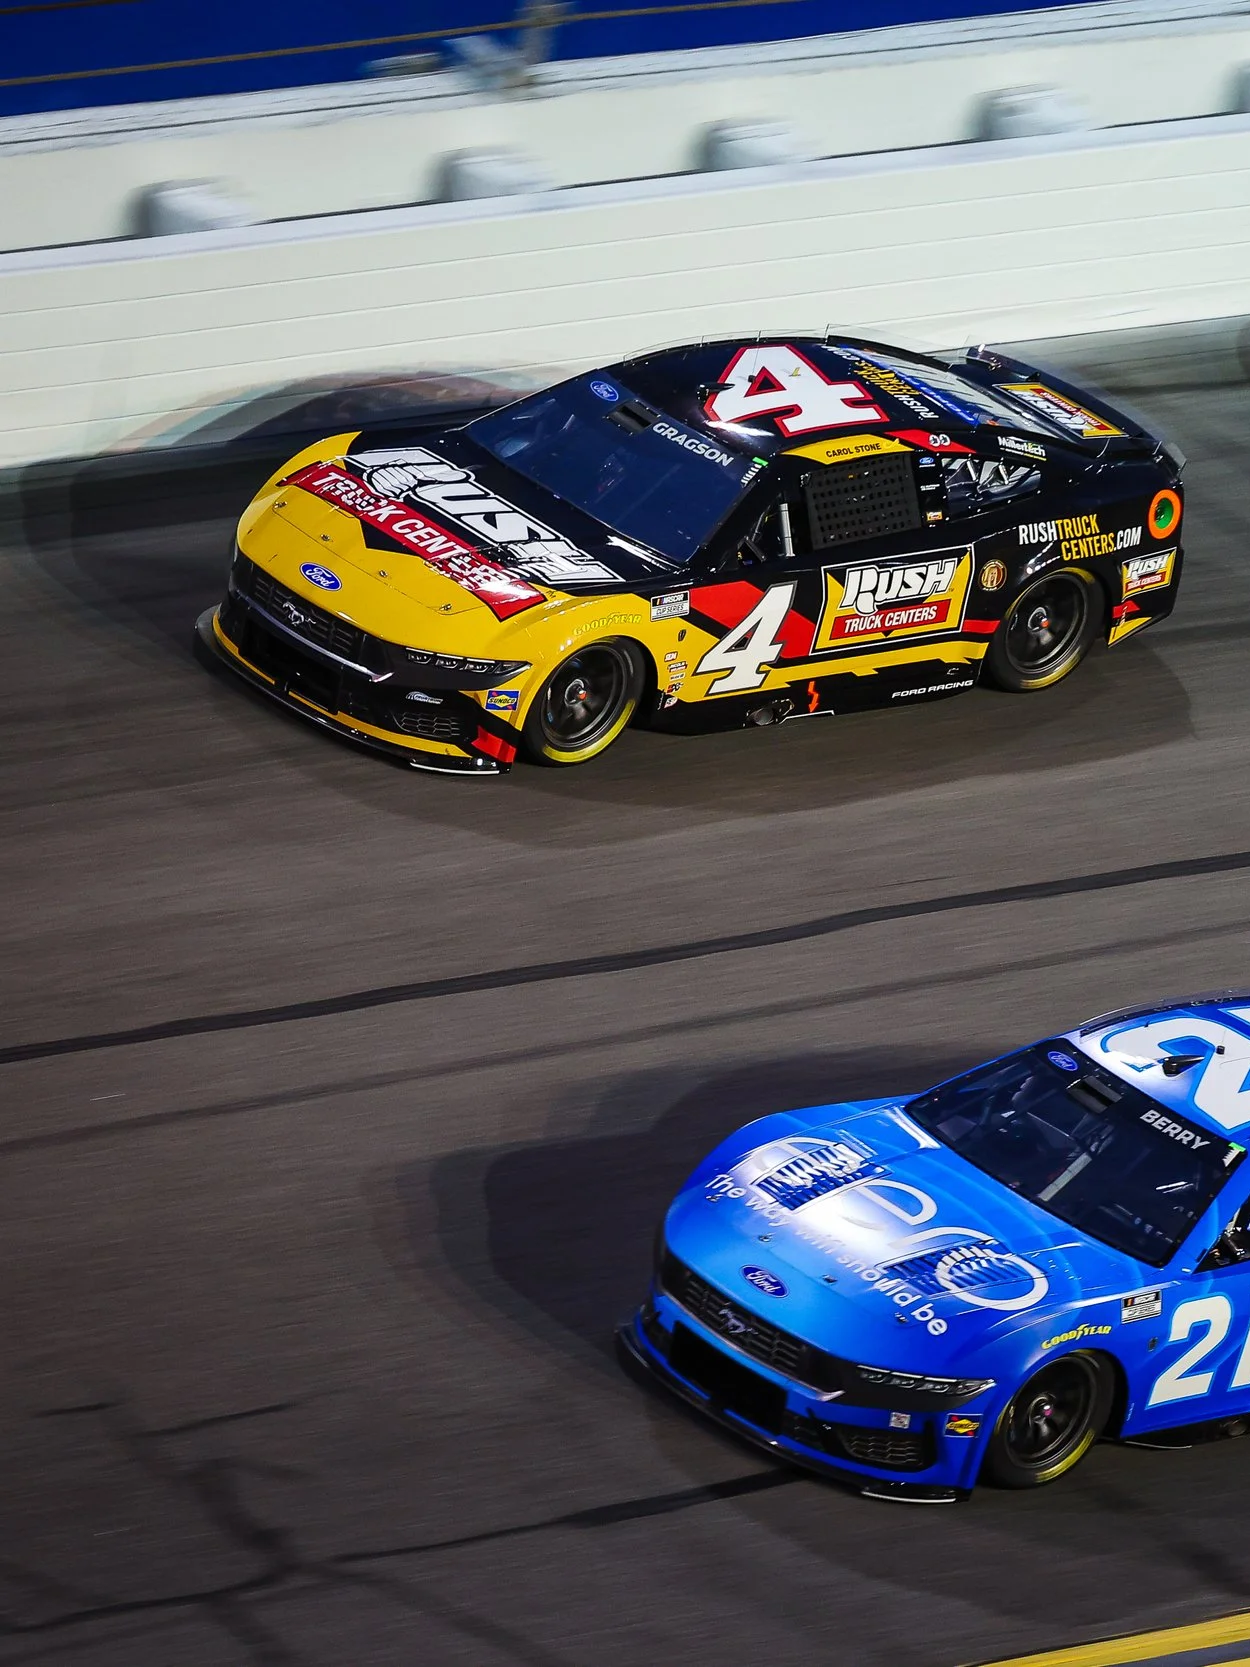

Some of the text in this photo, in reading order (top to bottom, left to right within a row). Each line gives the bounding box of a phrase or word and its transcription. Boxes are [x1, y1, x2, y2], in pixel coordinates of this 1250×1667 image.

[703, 344, 890, 438] 4
[653, 422, 734, 467] GRAGSON
[826, 443, 882, 459] CAROL STONE
[312, 471, 406, 524] TRUCK
[1061, 526, 1143, 561] CENTERS.COM
[1126, 553, 1171, 580] RUSH
[838, 558, 958, 615] RUSH
[573, 612, 642, 636] GOODYEAR
[844, 606, 937, 633] TRUCK CENTERS
[692, 581, 798, 697] 4
[488, 696, 517, 704] SUNOCO
[892, 680, 973, 698] FORD RACING
[1139, 1109, 1211, 1150] BERRY
[704, 1174, 747, 1199] The
[745, 1196, 792, 1227] way
[911, 1303, 948, 1336] be
[746, 1270, 781, 1293] Ford
[1041, 1323, 1112, 1349] GOODYEAR
